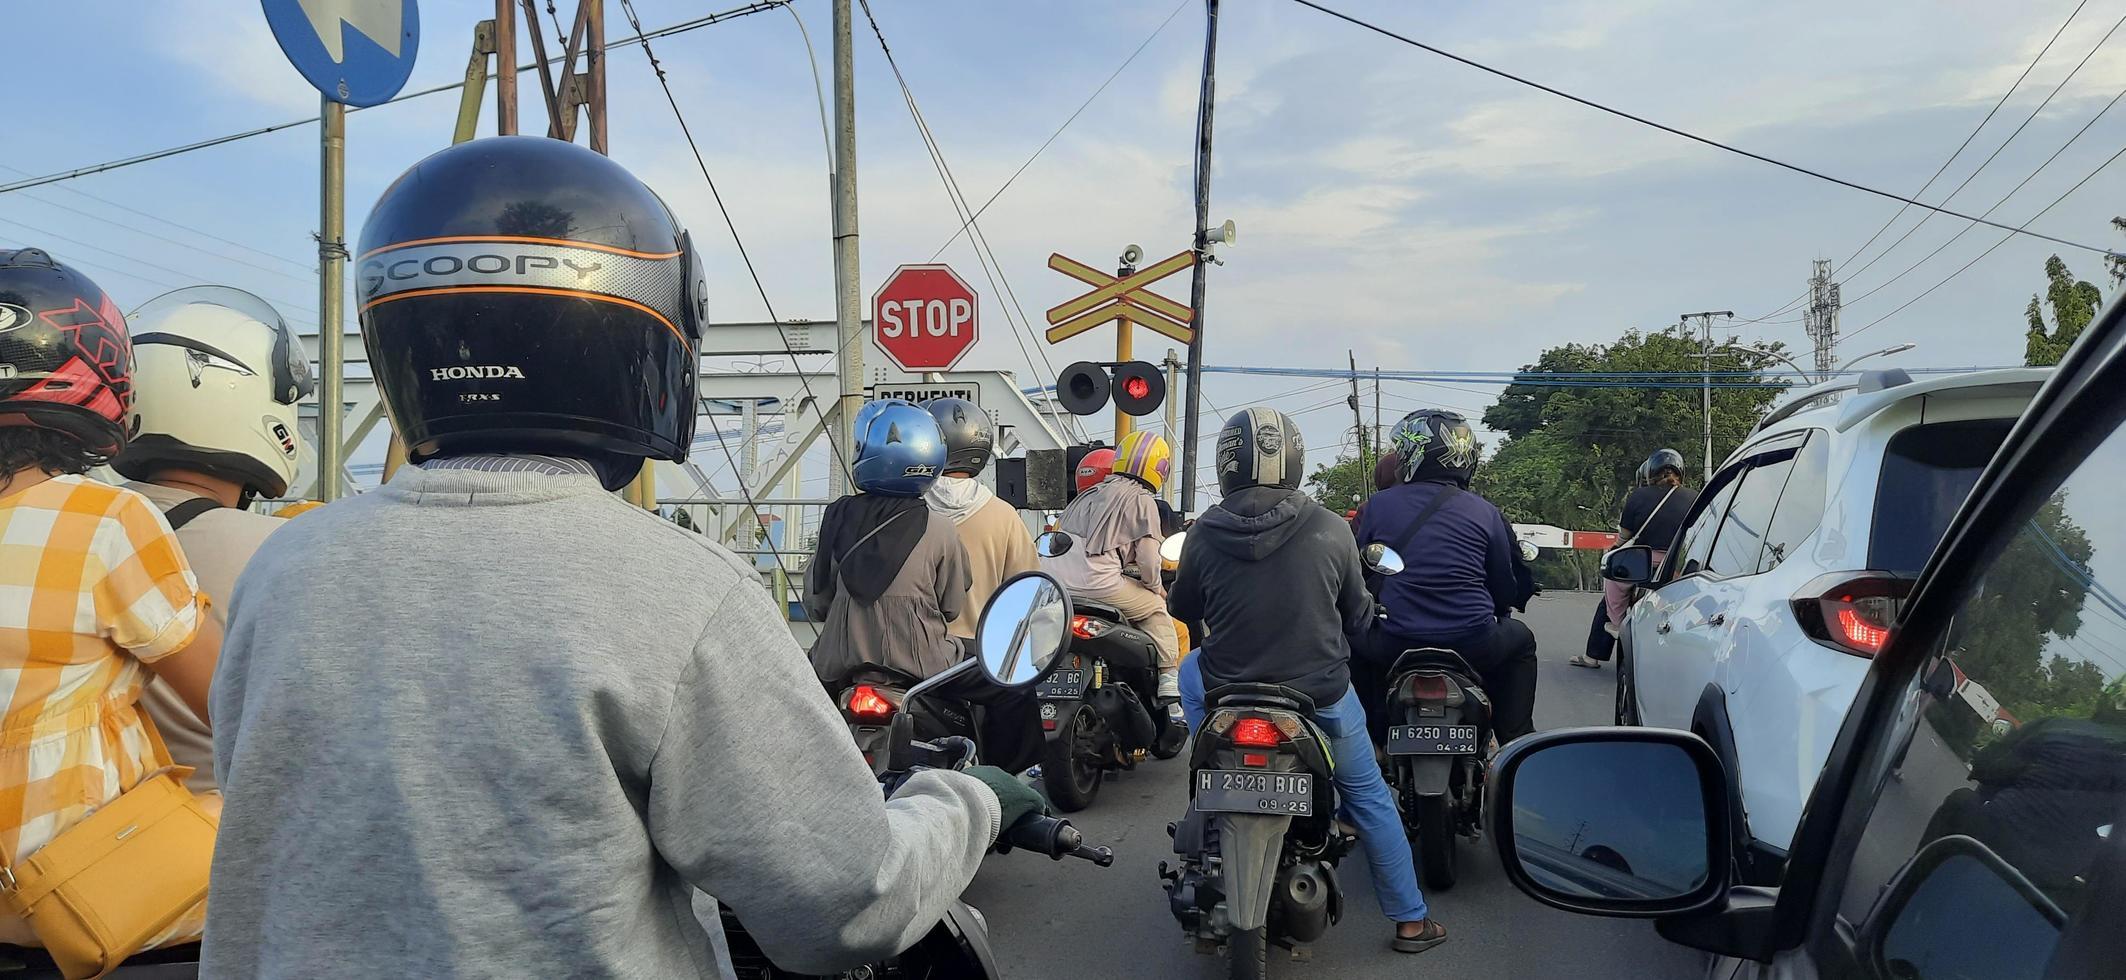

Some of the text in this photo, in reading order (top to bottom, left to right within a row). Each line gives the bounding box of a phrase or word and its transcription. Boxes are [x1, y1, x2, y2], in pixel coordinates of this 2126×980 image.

[881, 298, 972, 338] STOP
[430, 365, 525, 381] HONDA
[272, 423, 295, 454] GM
[1391, 727, 1474, 740] H 6250 BOG
[1201, 773, 1308, 794] H 2928 BIG
